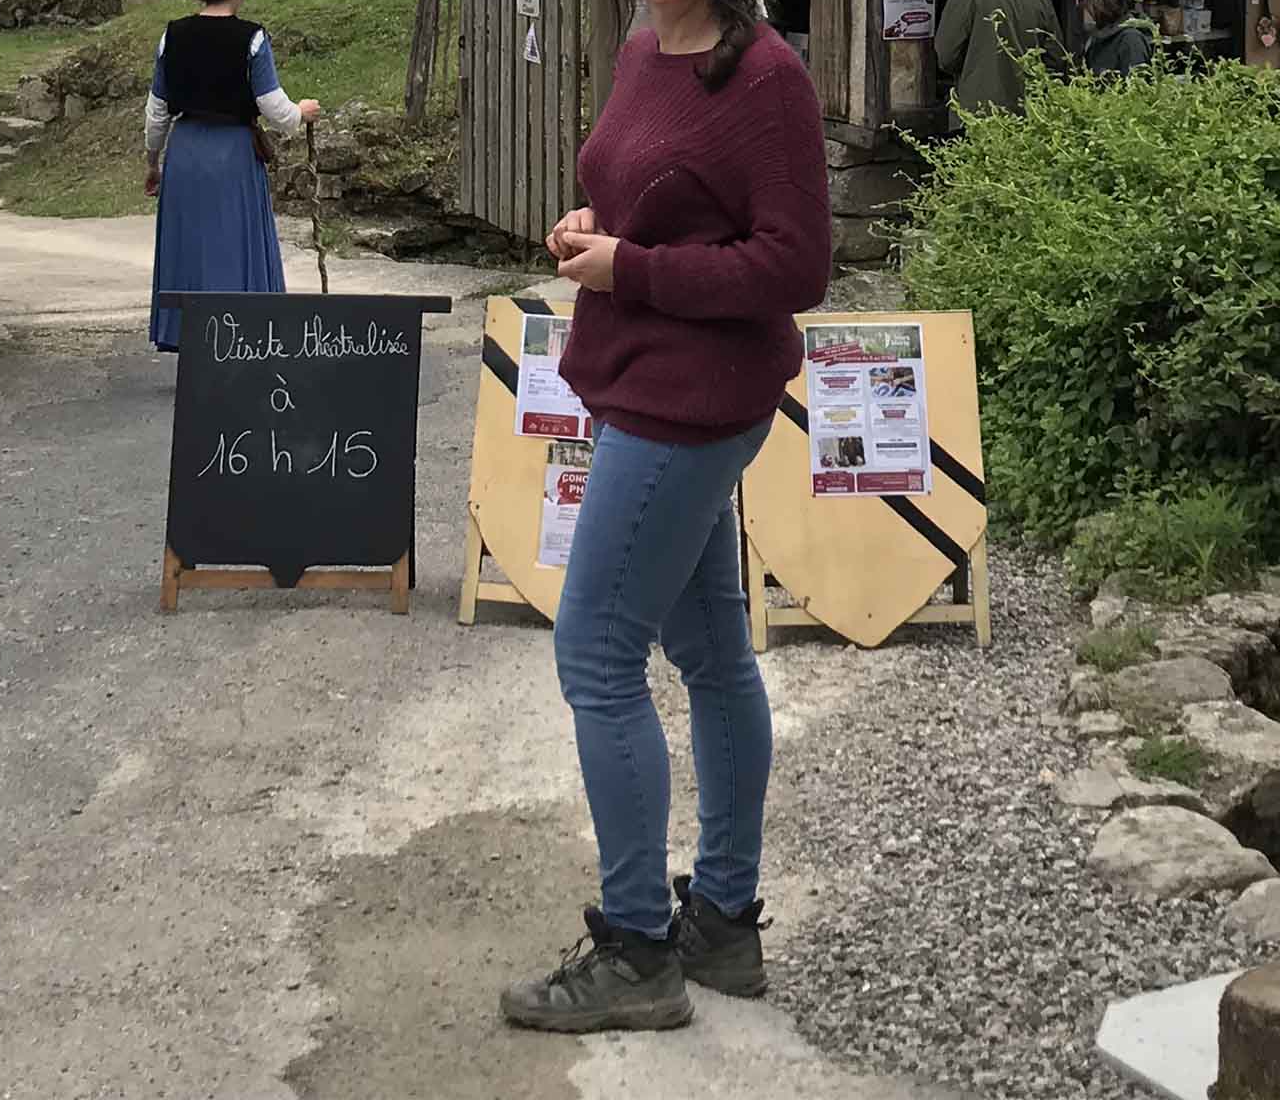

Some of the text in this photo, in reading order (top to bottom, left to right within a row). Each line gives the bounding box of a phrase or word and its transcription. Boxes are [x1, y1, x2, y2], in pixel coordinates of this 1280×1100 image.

[206, 313, 290, 362] Visite
[270, 373, 295, 412] à
[198, 429, 378, 477] 16 h 15
